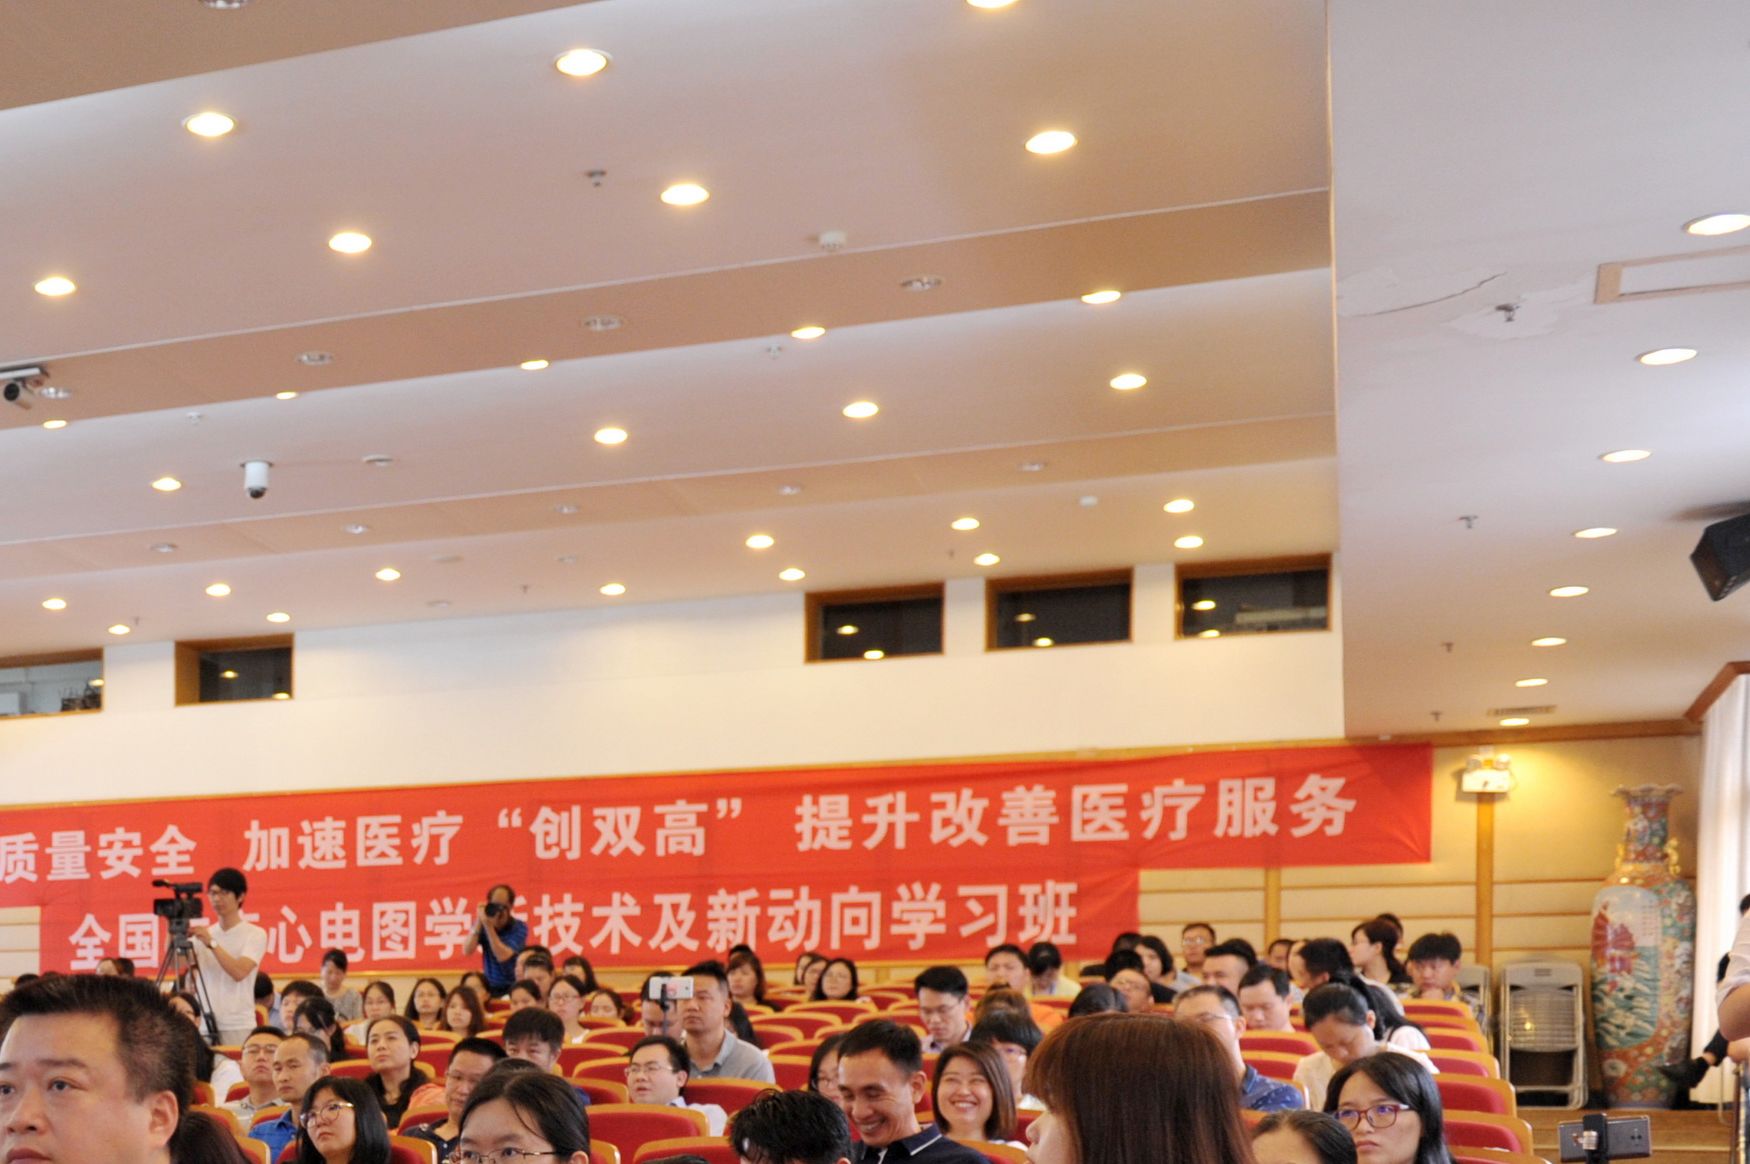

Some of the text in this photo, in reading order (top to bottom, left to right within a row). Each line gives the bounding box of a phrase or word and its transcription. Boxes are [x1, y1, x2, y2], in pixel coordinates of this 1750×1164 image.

[794, 773, 1358, 852] 提升改善医疗服务
[68, 879, 1078, 970] 全国心电图学技术及新动向学习班
